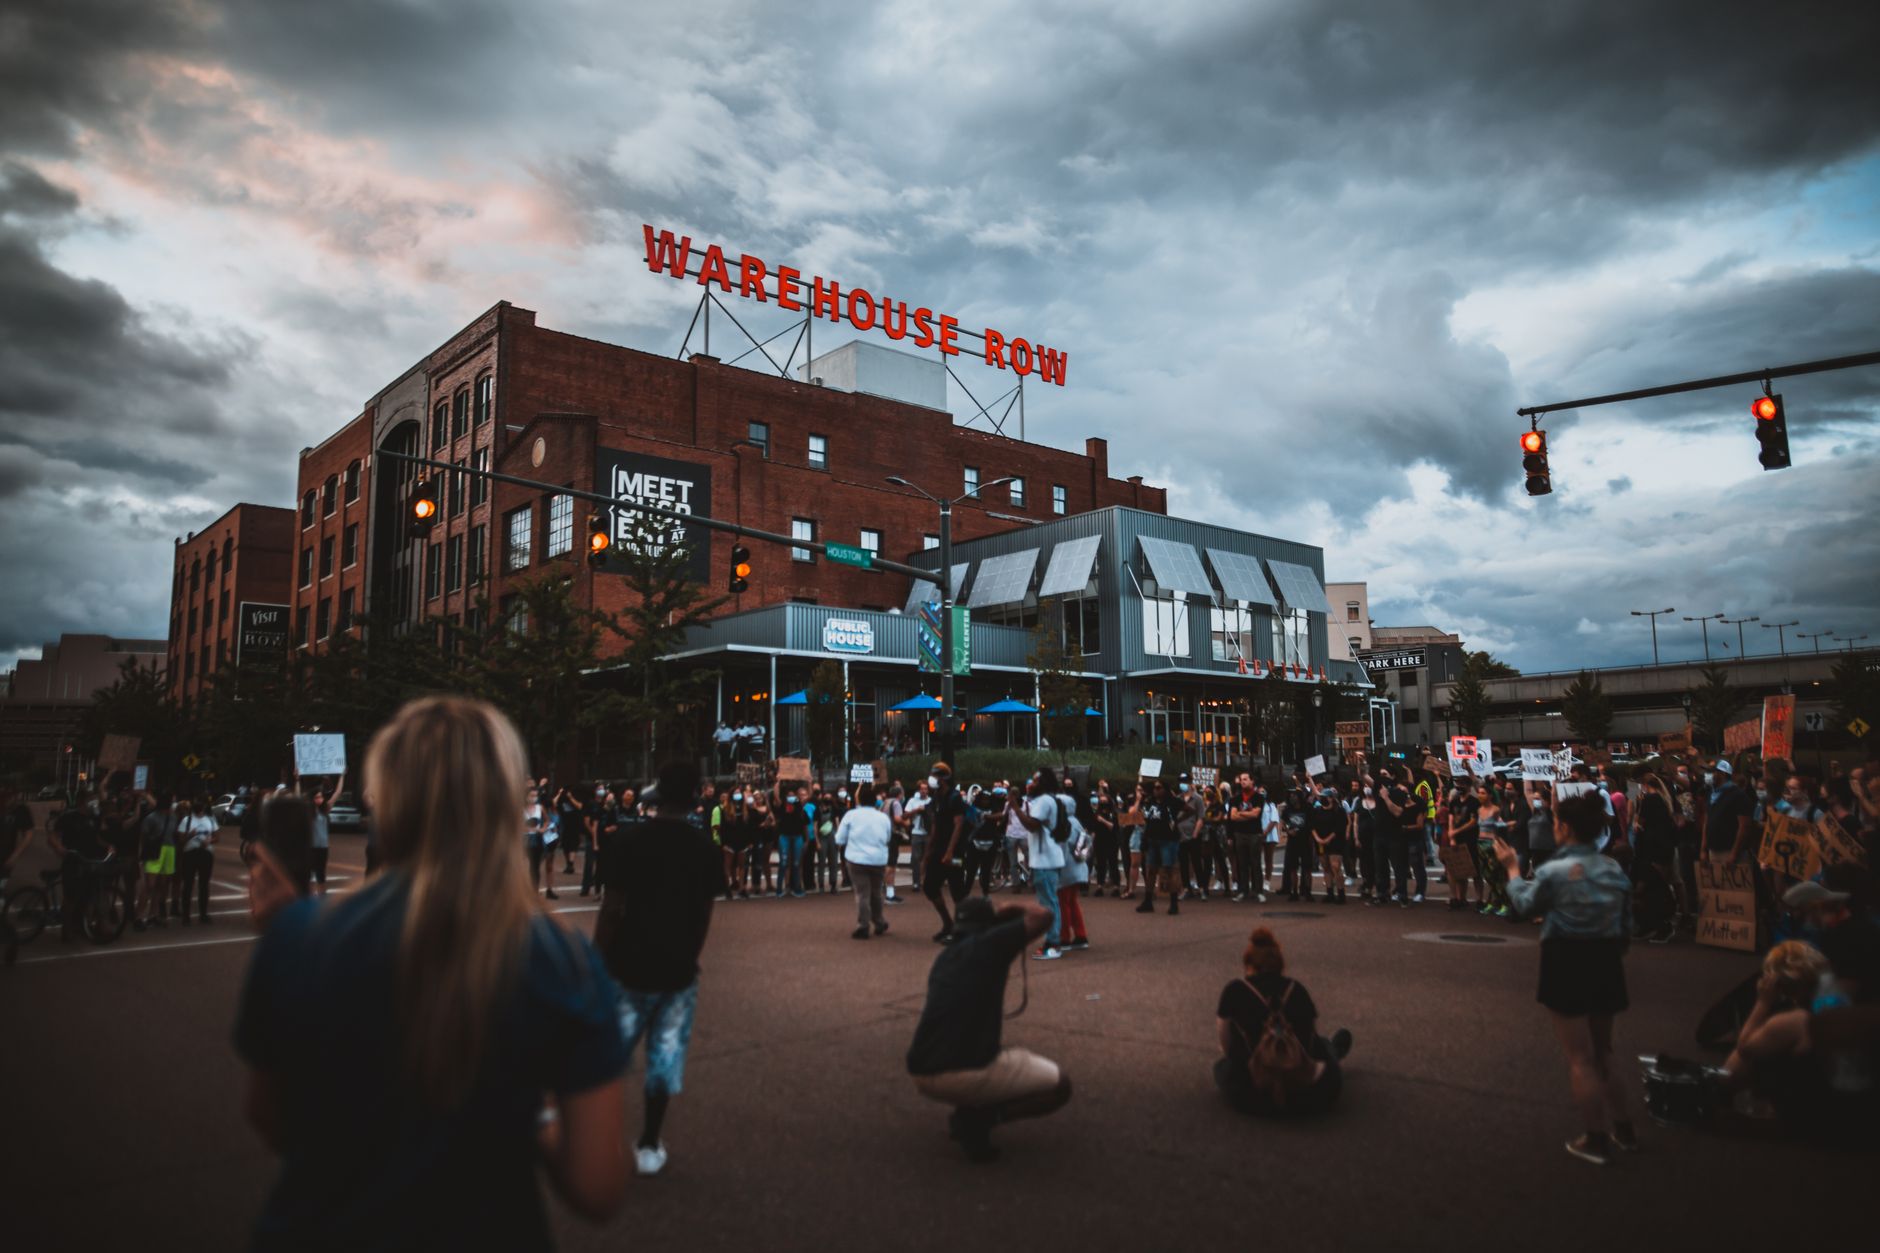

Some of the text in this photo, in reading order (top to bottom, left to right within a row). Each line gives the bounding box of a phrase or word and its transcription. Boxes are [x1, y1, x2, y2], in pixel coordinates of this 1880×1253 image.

[643, 224, 1067, 386] WAREHOUSE ROW
[618, 470, 693, 504] MEET
[827, 547, 861, 560] HOUSTON
[252, 610, 278, 626] VISIT
[831, 620, 868, 633] PUBLIC
[963, 610, 971, 648] CENTER
[827, 632, 871, 646] HOUSE
[1394, 656, 1421, 666] HERE
[1238, 658, 1328, 680] REVIVAL
[1348, 737, 1359, 746] TO
